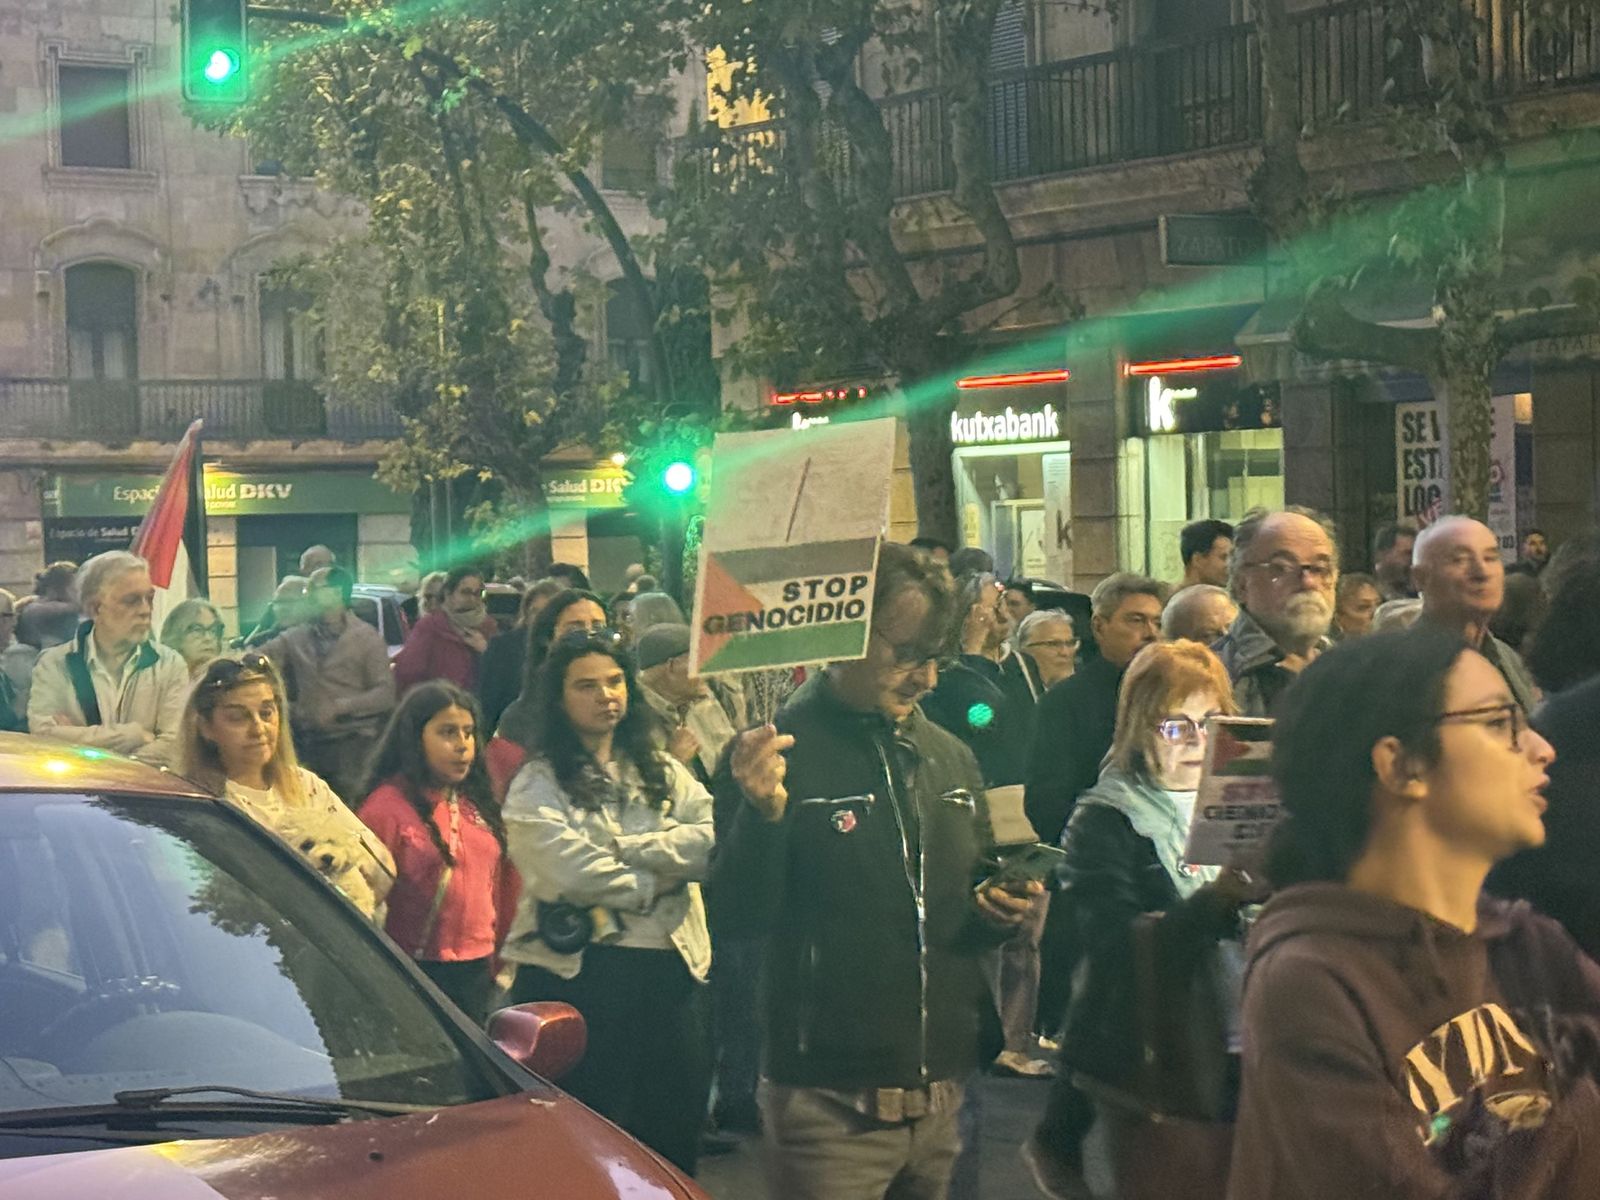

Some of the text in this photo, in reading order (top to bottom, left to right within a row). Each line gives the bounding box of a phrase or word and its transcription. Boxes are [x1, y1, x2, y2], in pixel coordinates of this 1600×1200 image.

[951, 404, 1059, 442] kutxabank
[1402, 410, 1427, 443] SE
[203, 484, 236, 499] alud
[239, 483, 293, 499] DKV
[549, 480, 587, 494] Salud
[1403, 484, 1442, 517] LOC
[100, 527, 129, 537] Salud
[783, 575, 868, 602] STOP
[703, 599, 865, 635] GENOCIDIO
